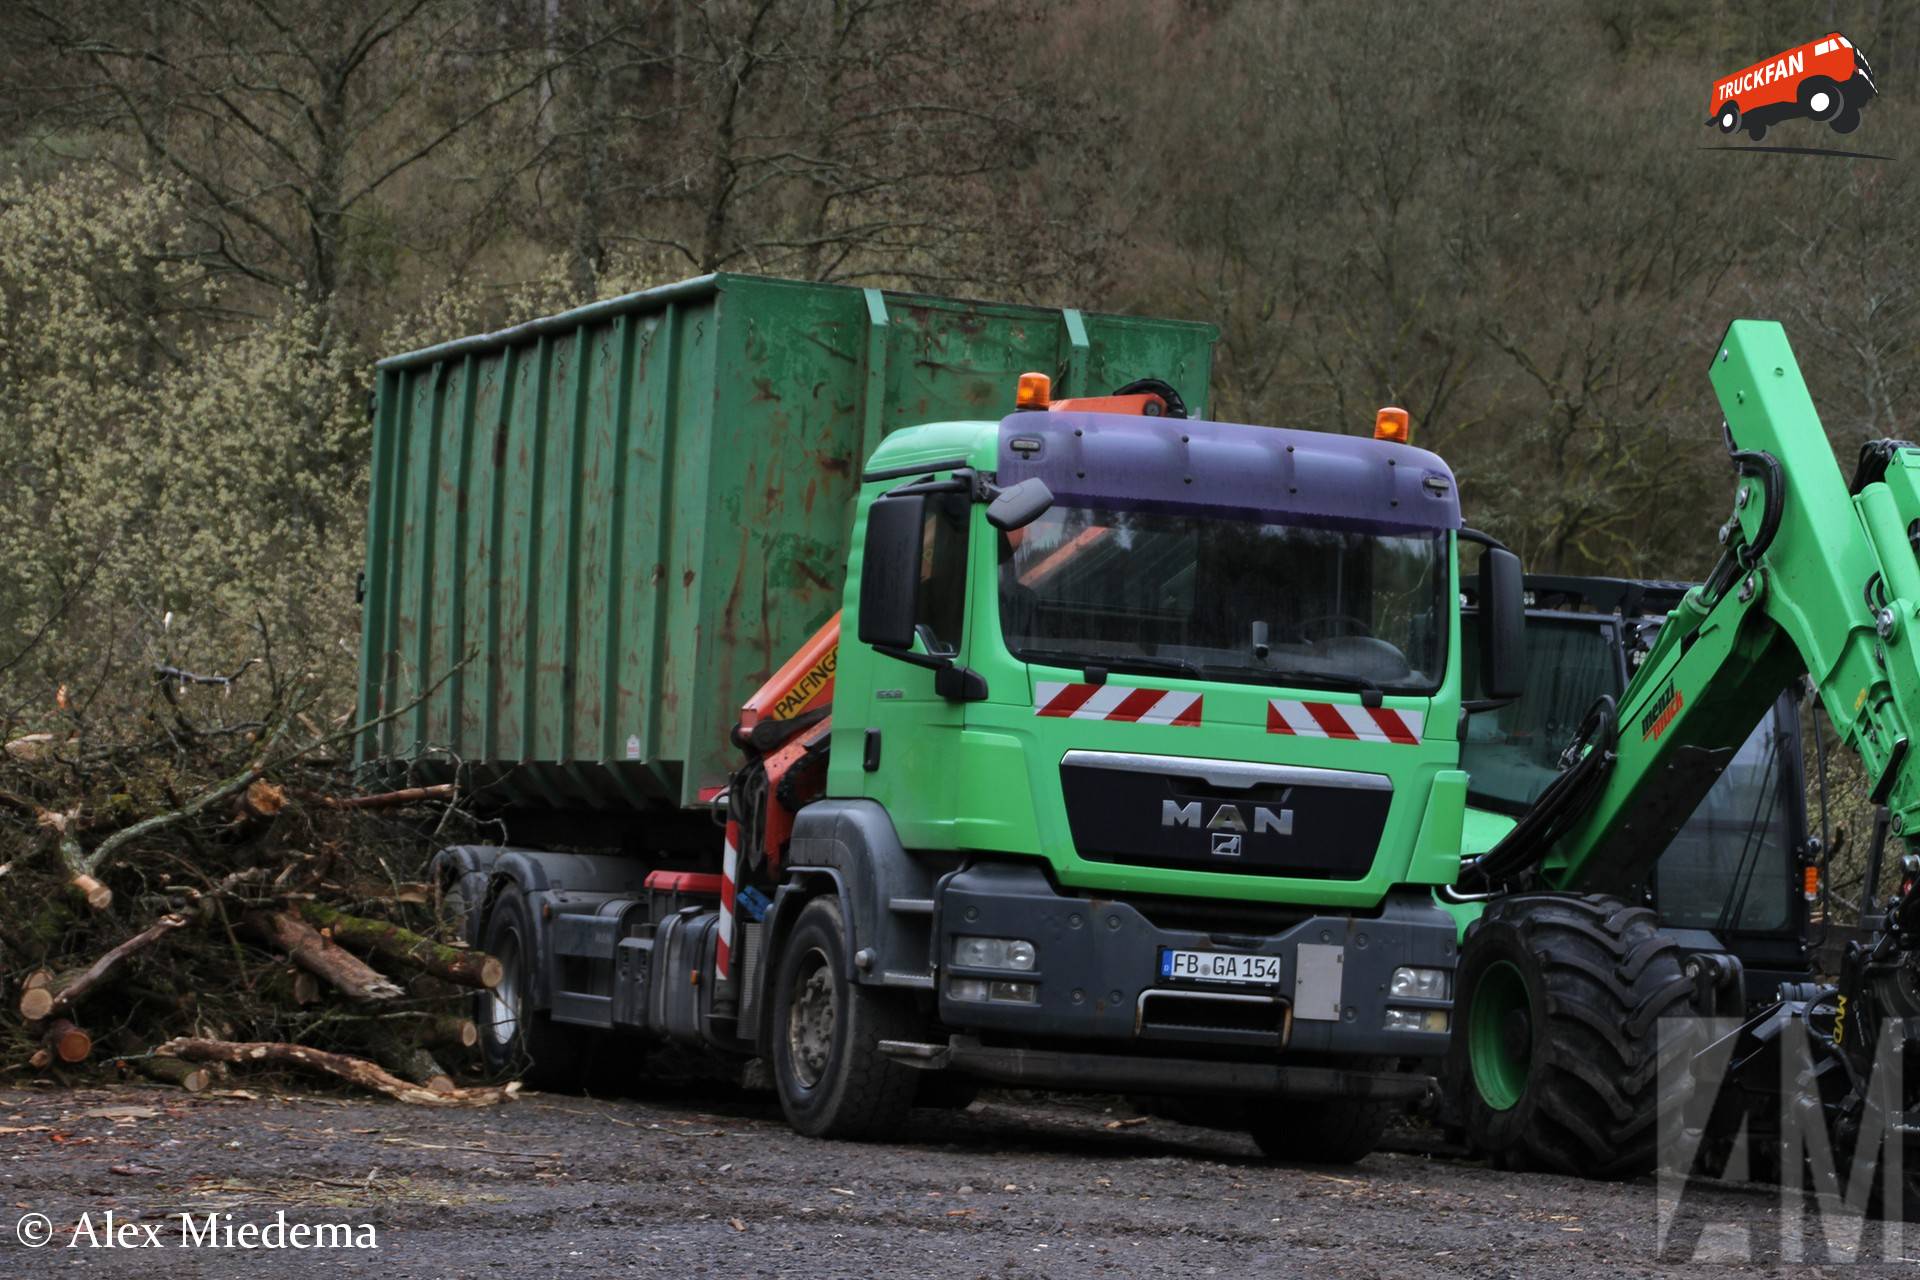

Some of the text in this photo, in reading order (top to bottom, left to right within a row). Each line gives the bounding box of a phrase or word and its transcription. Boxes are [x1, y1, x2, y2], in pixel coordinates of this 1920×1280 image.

[1161, 799, 1294, 836] MAN
[1173, 953, 1199, 975] FB
[1212, 956, 1238, 977] GA
[1242, 958, 1278, 979] 154
